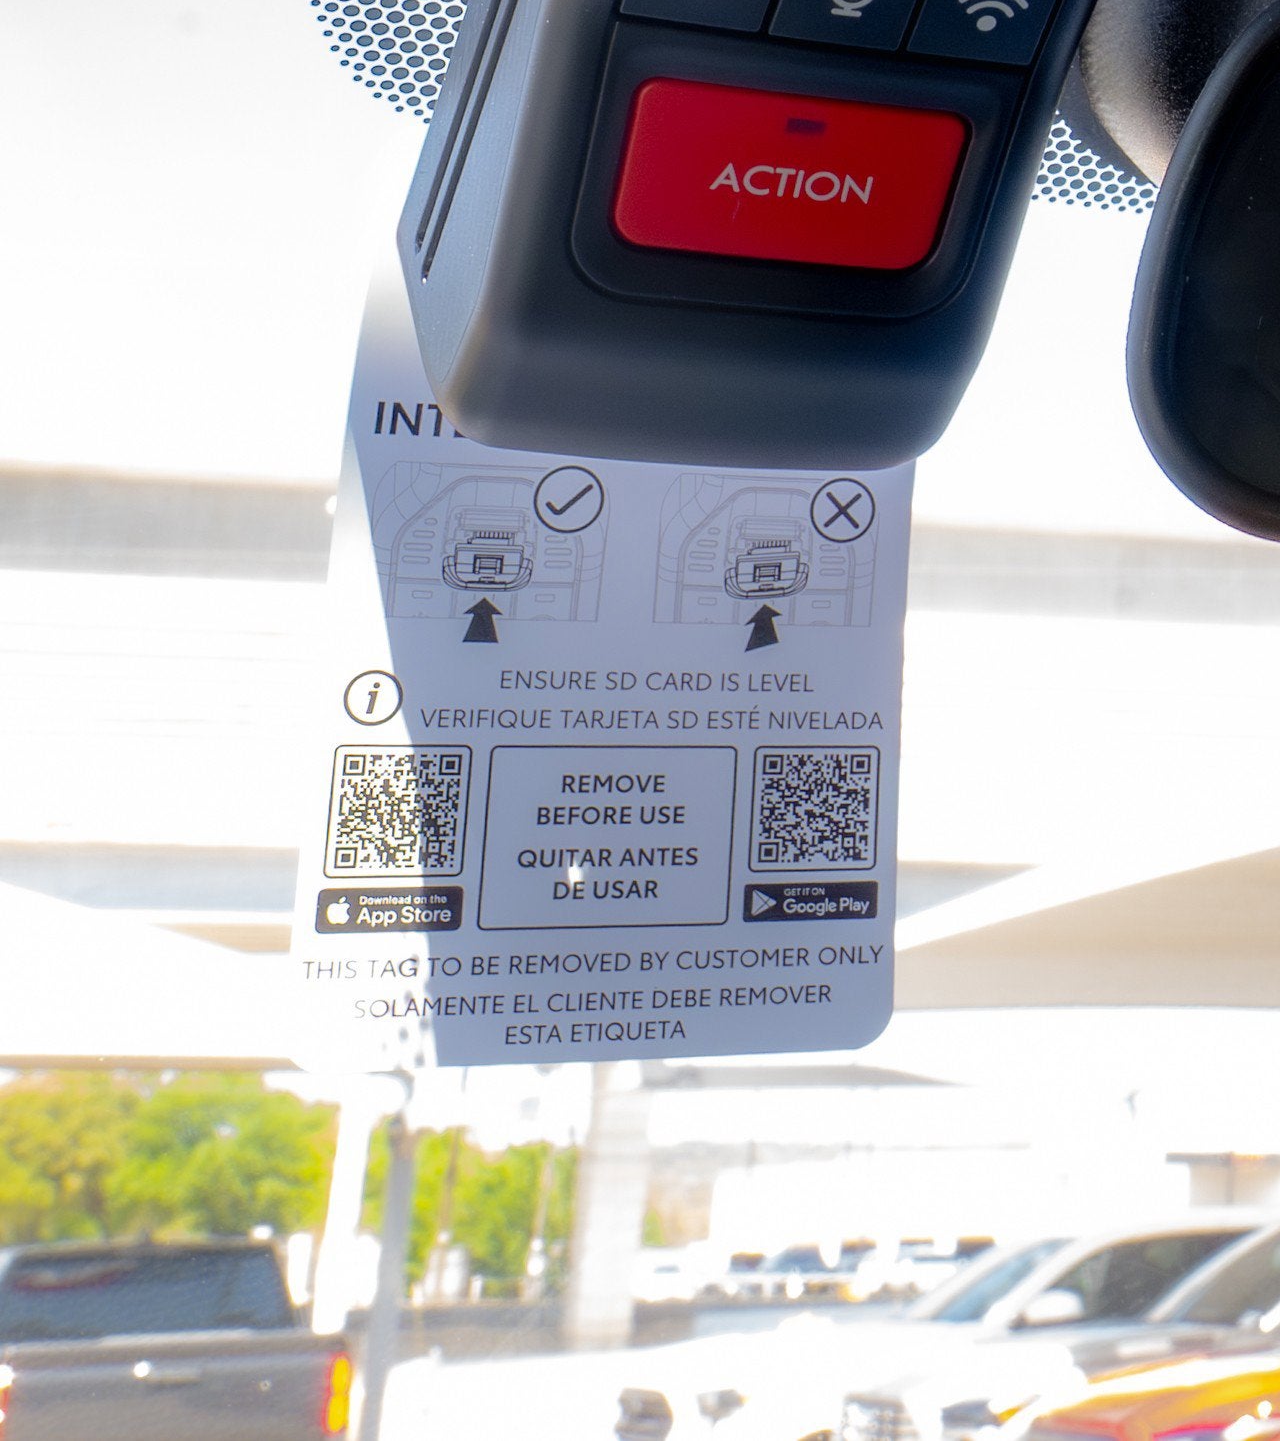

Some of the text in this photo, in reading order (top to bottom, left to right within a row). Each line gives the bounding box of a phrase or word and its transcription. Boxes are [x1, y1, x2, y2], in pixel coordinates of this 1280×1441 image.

[709, 163, 874, 205] ACTION
[374, 401, 466, 438] INT
[500, 670, 814, 693] ENSURE SD CARD IS LEVEL
[420, 705, 884, 731] VERIFIQUE TARJETA SD ESTÉ NIVELADA
[561, 775, 666, 794] REMOVE
[536, 806, 685, 826] BEFORE USE
[517, 847, 699, 868] QUITAR ANTES
[359, 894, 447, 905] Download on the
[551, 880, 658, 900] DE USAR
[783, 888, 801, 896] GET
[811, 887, 825, 895] ON
[356, 905, 451, 927] App Store
[782, 897, 870, 916] Google Play
[302, 945, 884, 979] THIS TAG TO BE REMOVED BY CUSTOMER ONLY
[353, 985, 831, 1019] SOLAMENTE EL CLIENTE DEBE REMOVER
[504, 1021, 687, 1045] ESTA ETIQUETA
